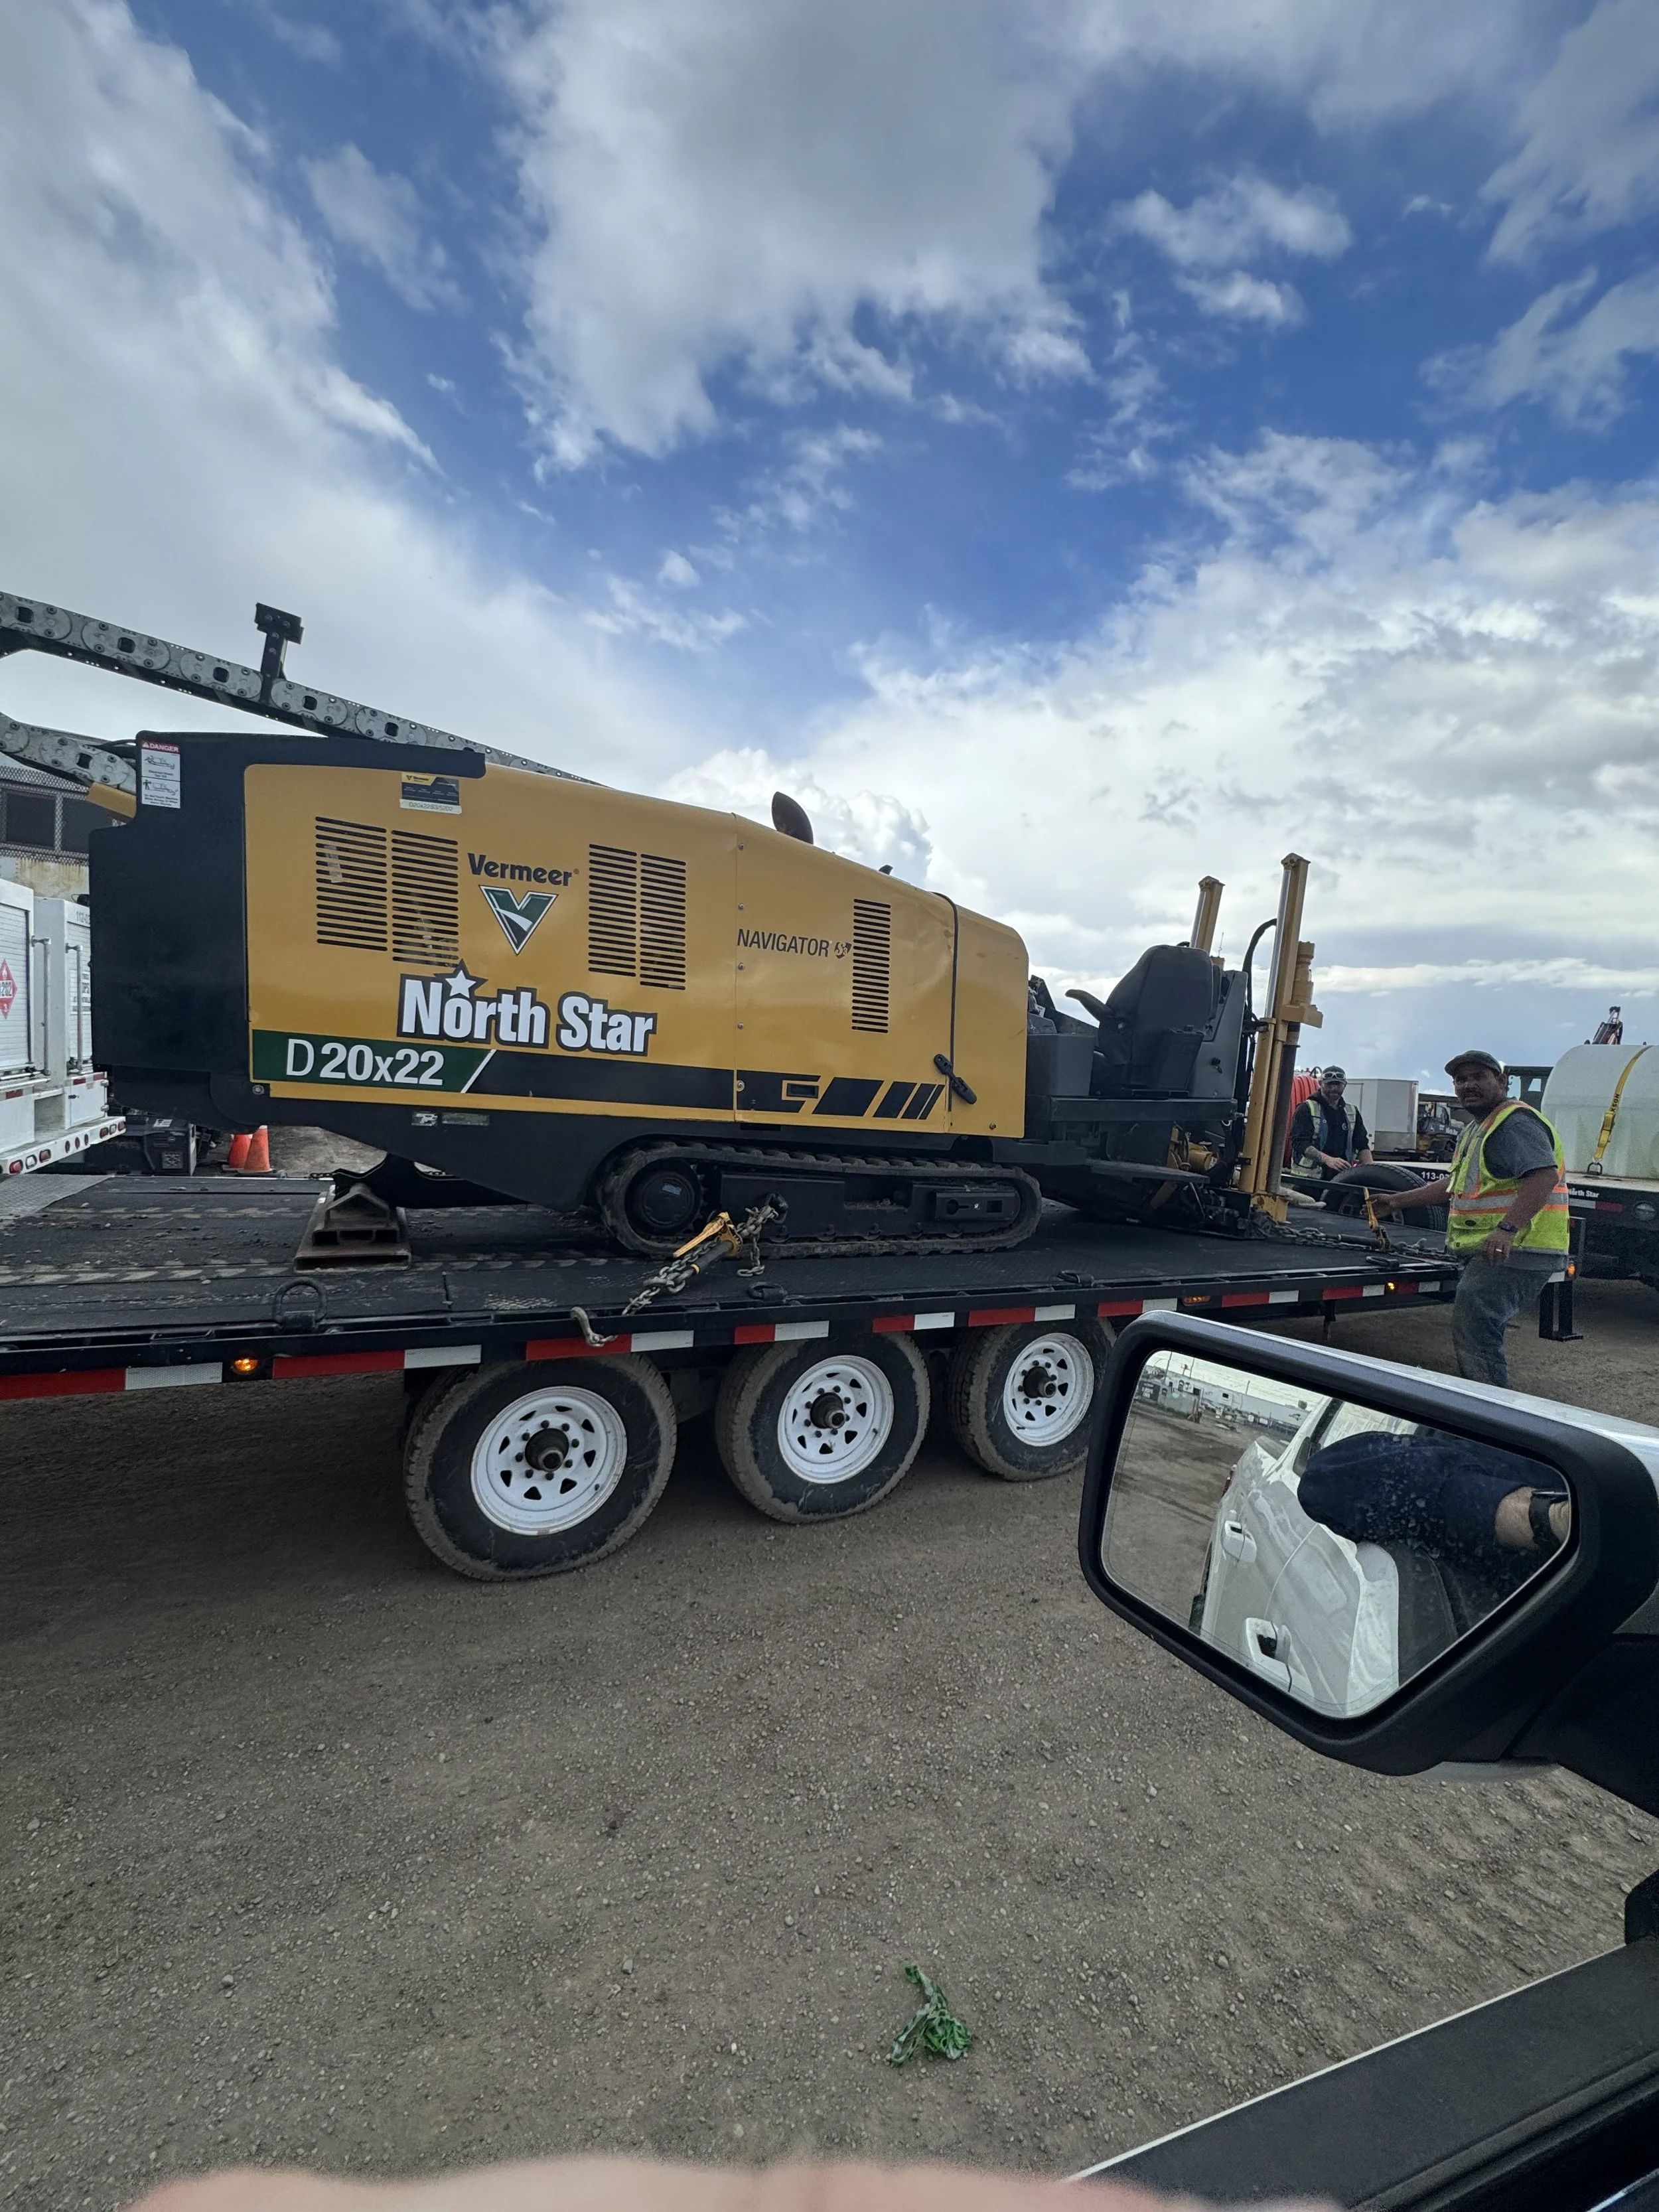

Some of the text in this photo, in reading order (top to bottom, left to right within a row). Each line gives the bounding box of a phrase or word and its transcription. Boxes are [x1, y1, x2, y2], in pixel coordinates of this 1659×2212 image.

[149, 743, 179, 753] DANGER
[467, 853, 572, 887] Vermeer
[737, 928, 830, 957] NAVIGATOR
[401, 978, 654, 1053] North Star
